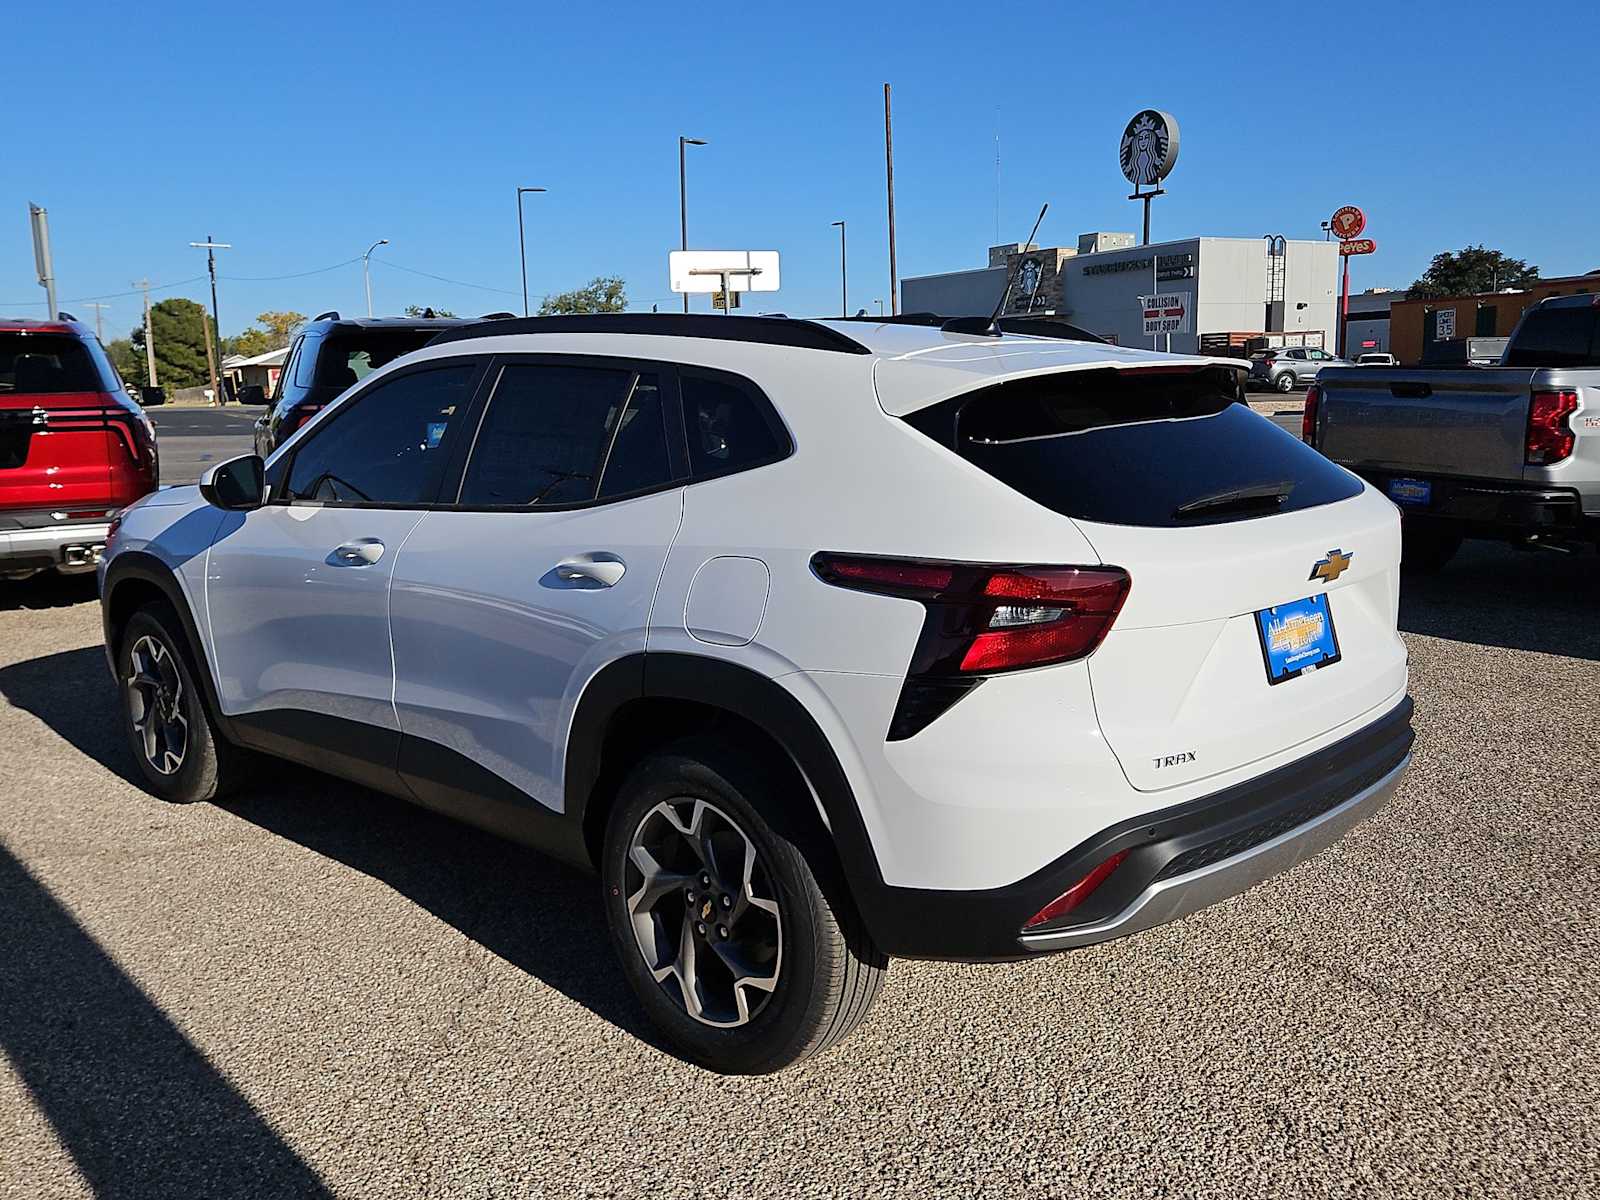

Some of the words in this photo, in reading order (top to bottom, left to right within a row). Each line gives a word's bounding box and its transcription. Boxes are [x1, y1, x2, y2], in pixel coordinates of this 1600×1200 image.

[1340, 213, 1355, 230] P
[1147, 296, 1180, 308] COLLISION
[1162, 319, 1180, 332] SHOP
[1439, 325, 1453, 336] 35
[1152, 751, 1196, 768] TRAX
